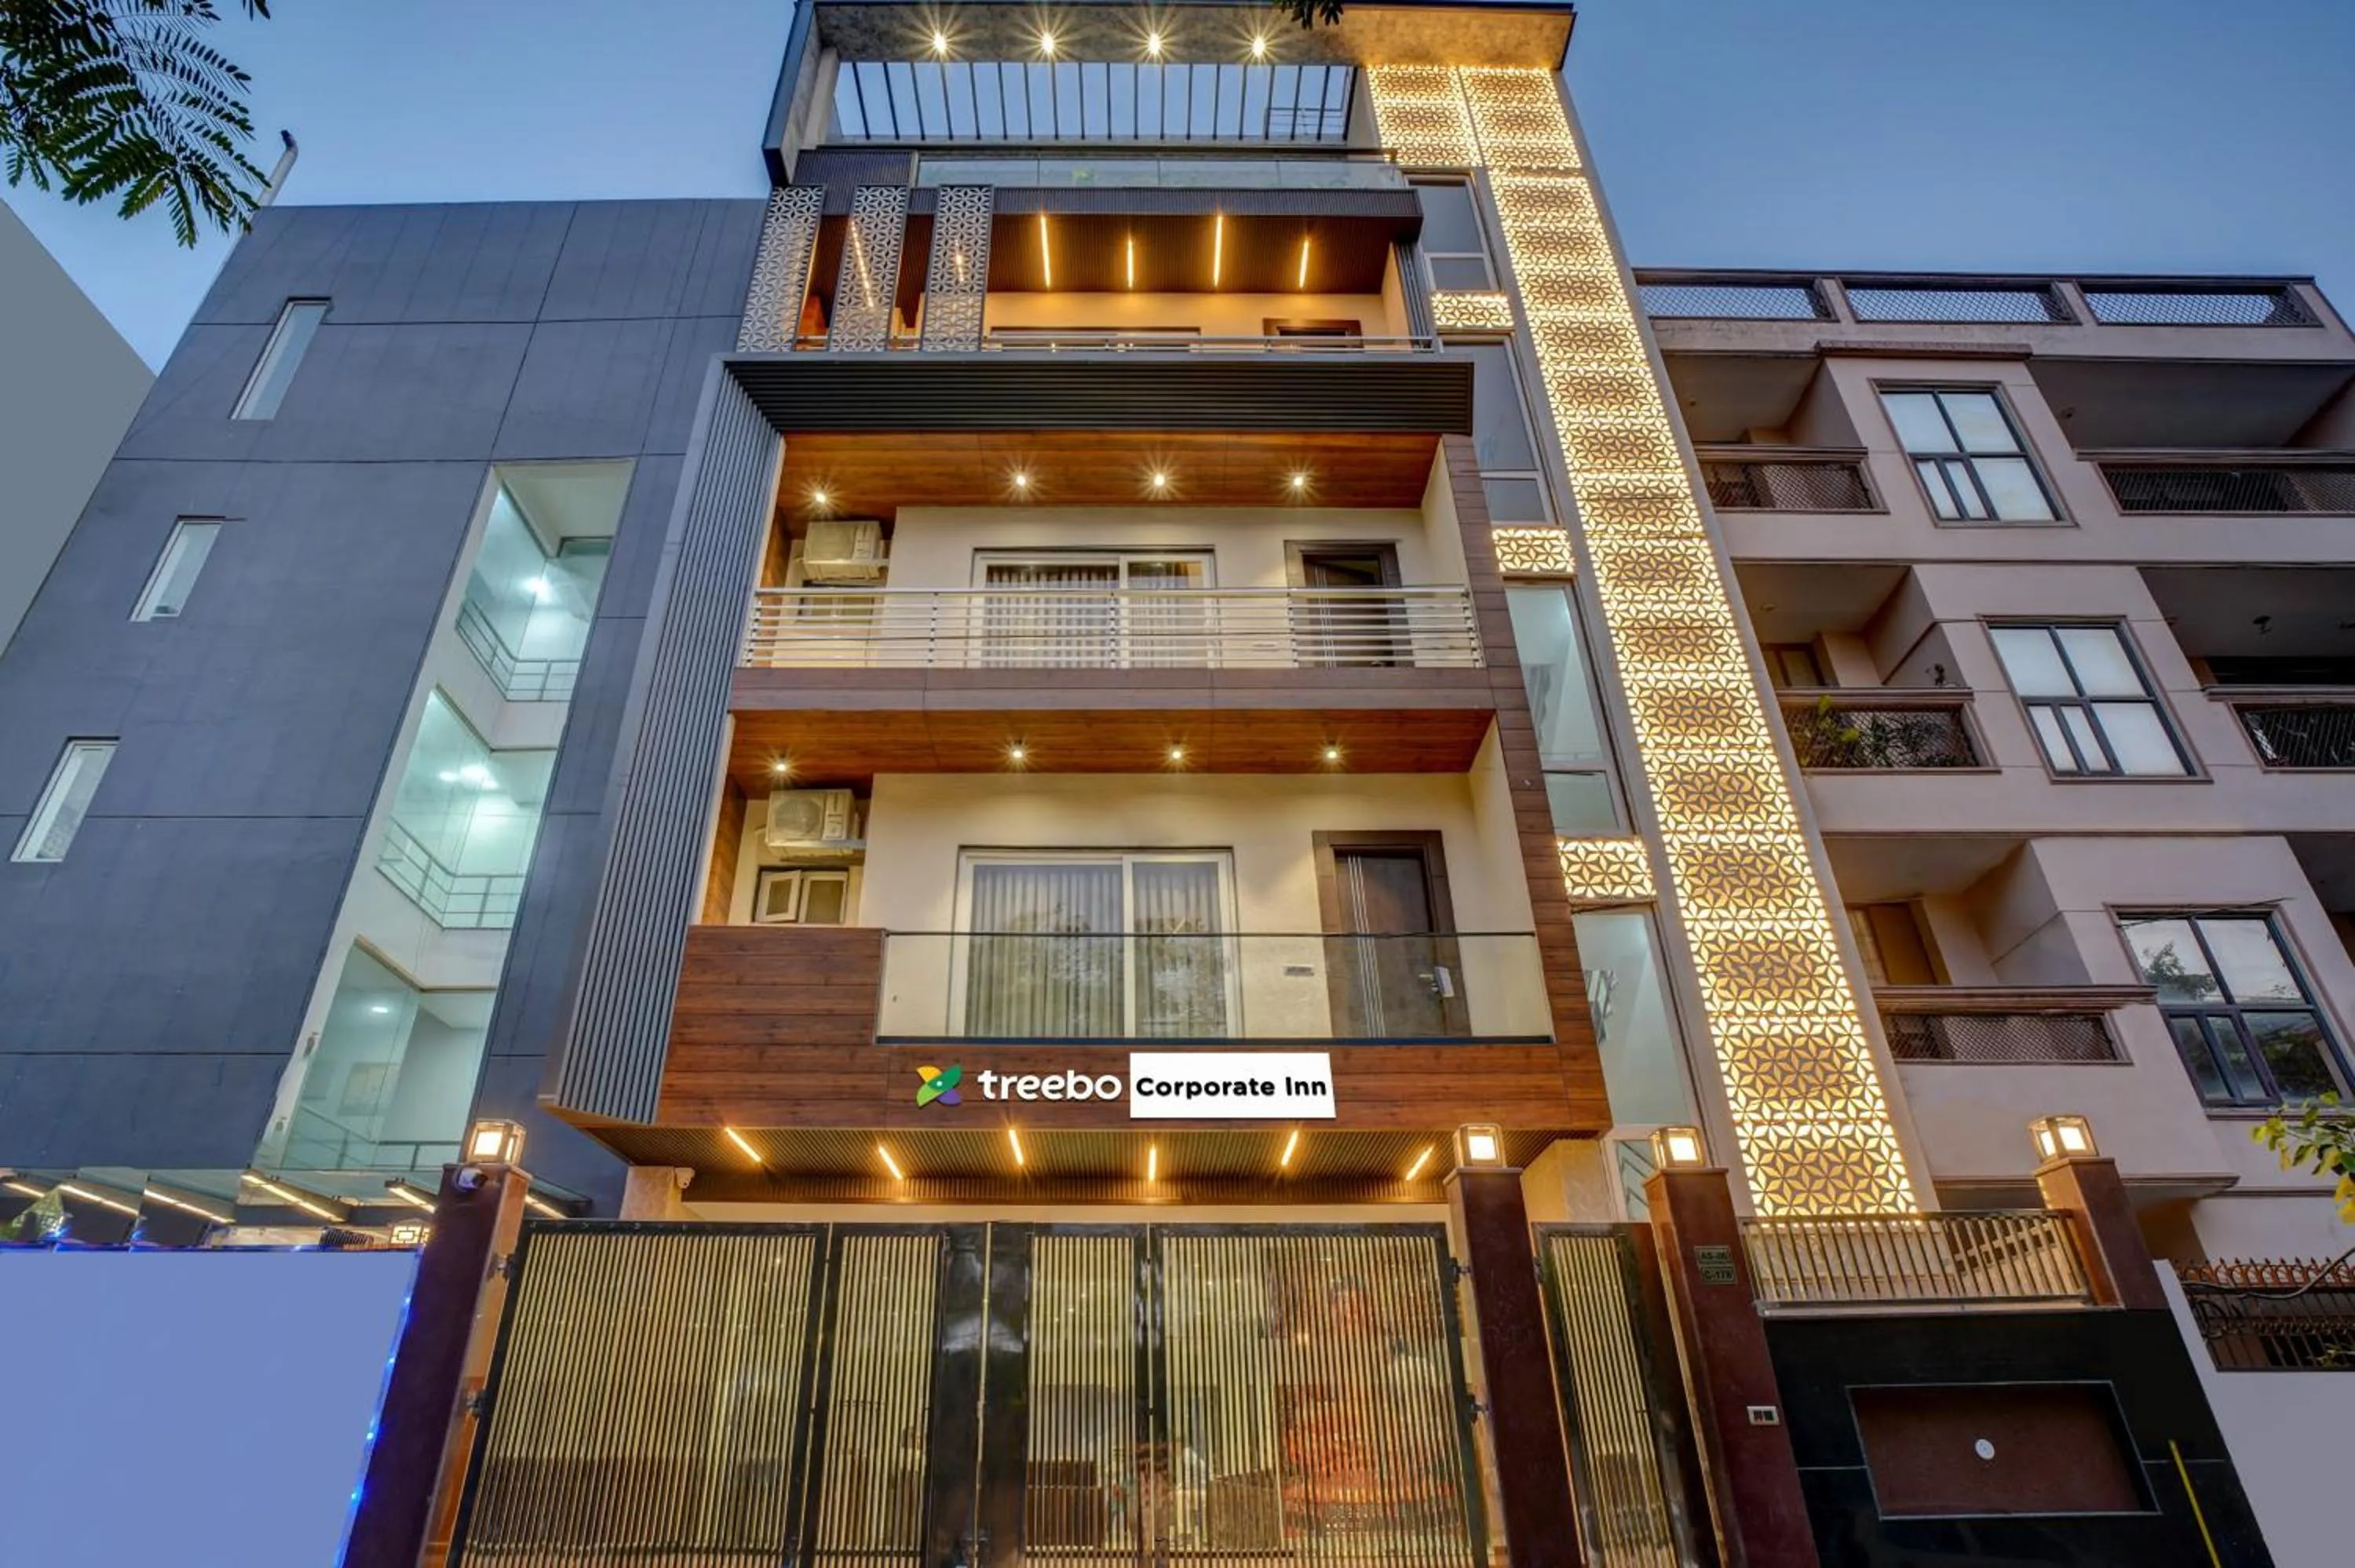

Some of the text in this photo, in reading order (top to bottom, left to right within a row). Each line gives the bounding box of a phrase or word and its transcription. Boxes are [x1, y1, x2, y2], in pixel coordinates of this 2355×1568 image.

[977, 1070, 1327, 1099] treebo Corporate Inn
